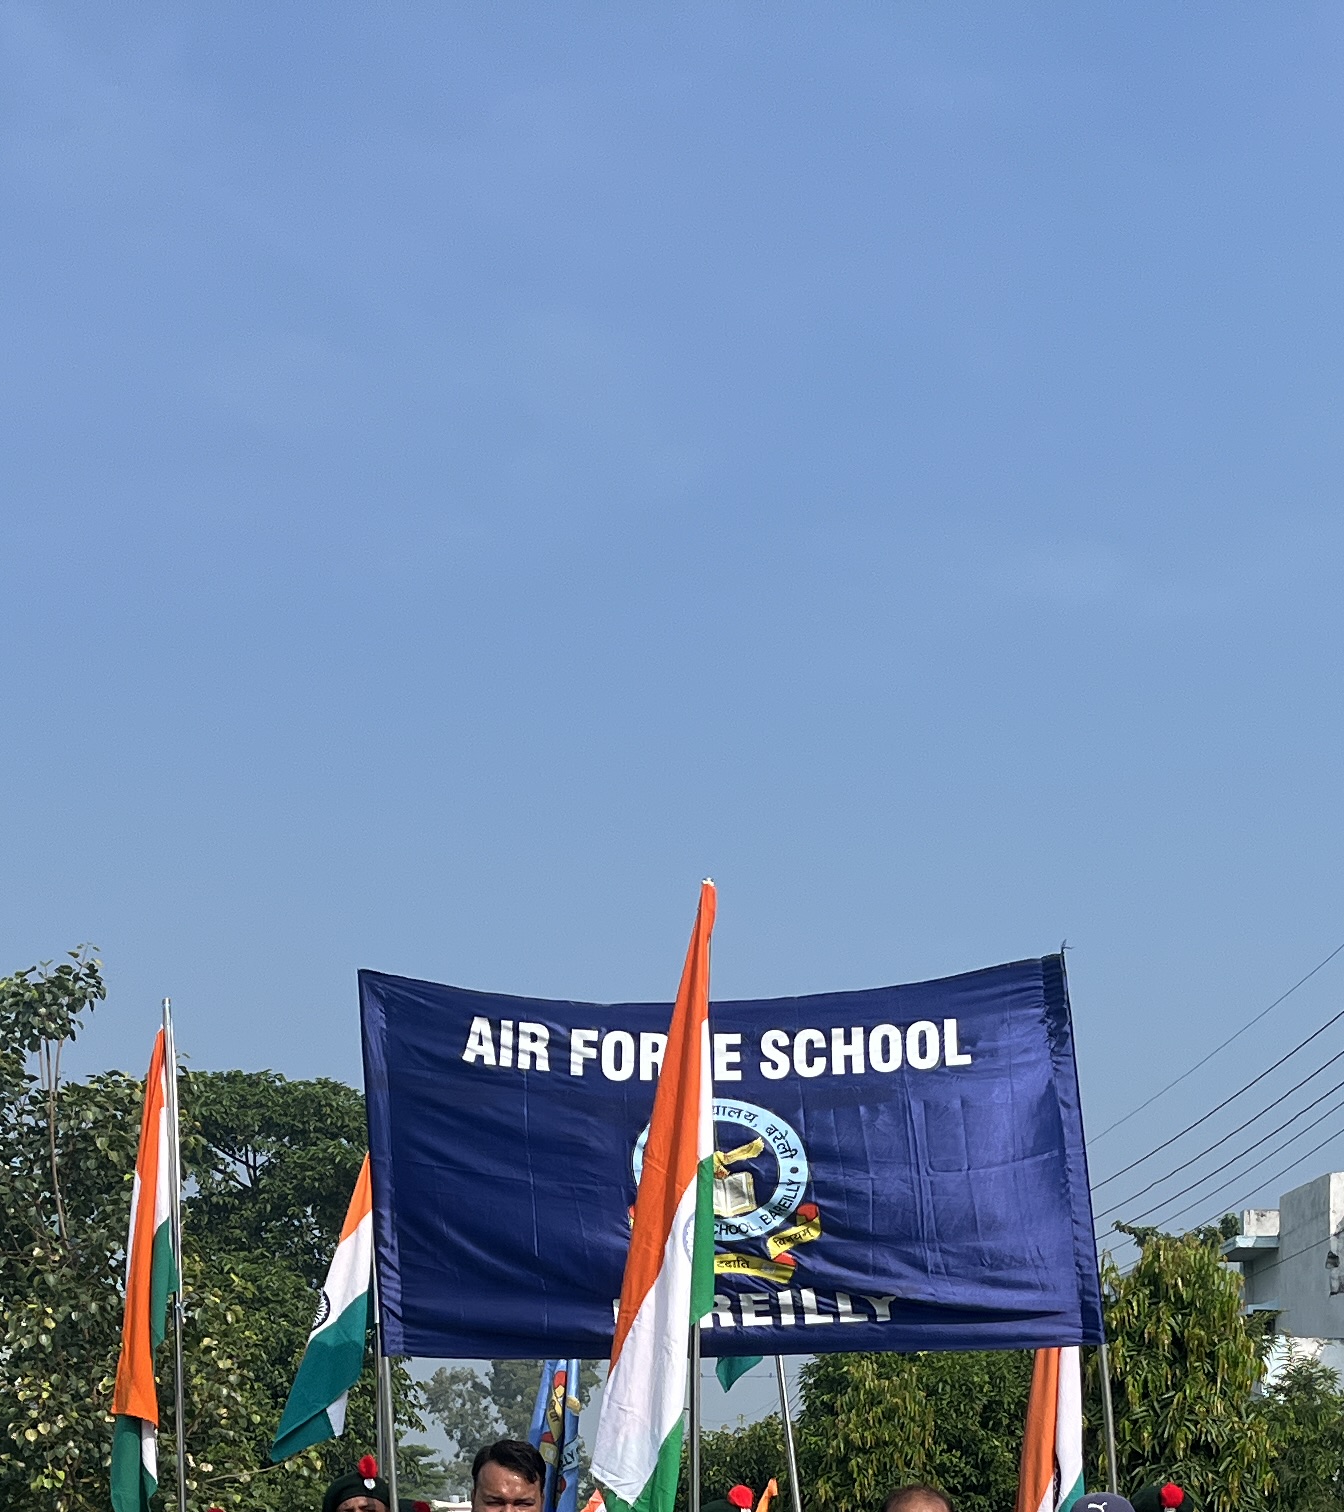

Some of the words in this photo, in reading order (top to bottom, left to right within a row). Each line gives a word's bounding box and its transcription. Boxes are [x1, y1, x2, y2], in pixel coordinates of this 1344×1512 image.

[462, 1016, 550, 1072] AIR
[570, 1029, 742, 1081] FORE
[759, 1018, 972, 1080] SCHOOL
[764, 1123, 799, 1160] बरेली
[713, 1222, 763, 1236] CHOOL,
[759, 1178, 801, 1226] BAREILLY
